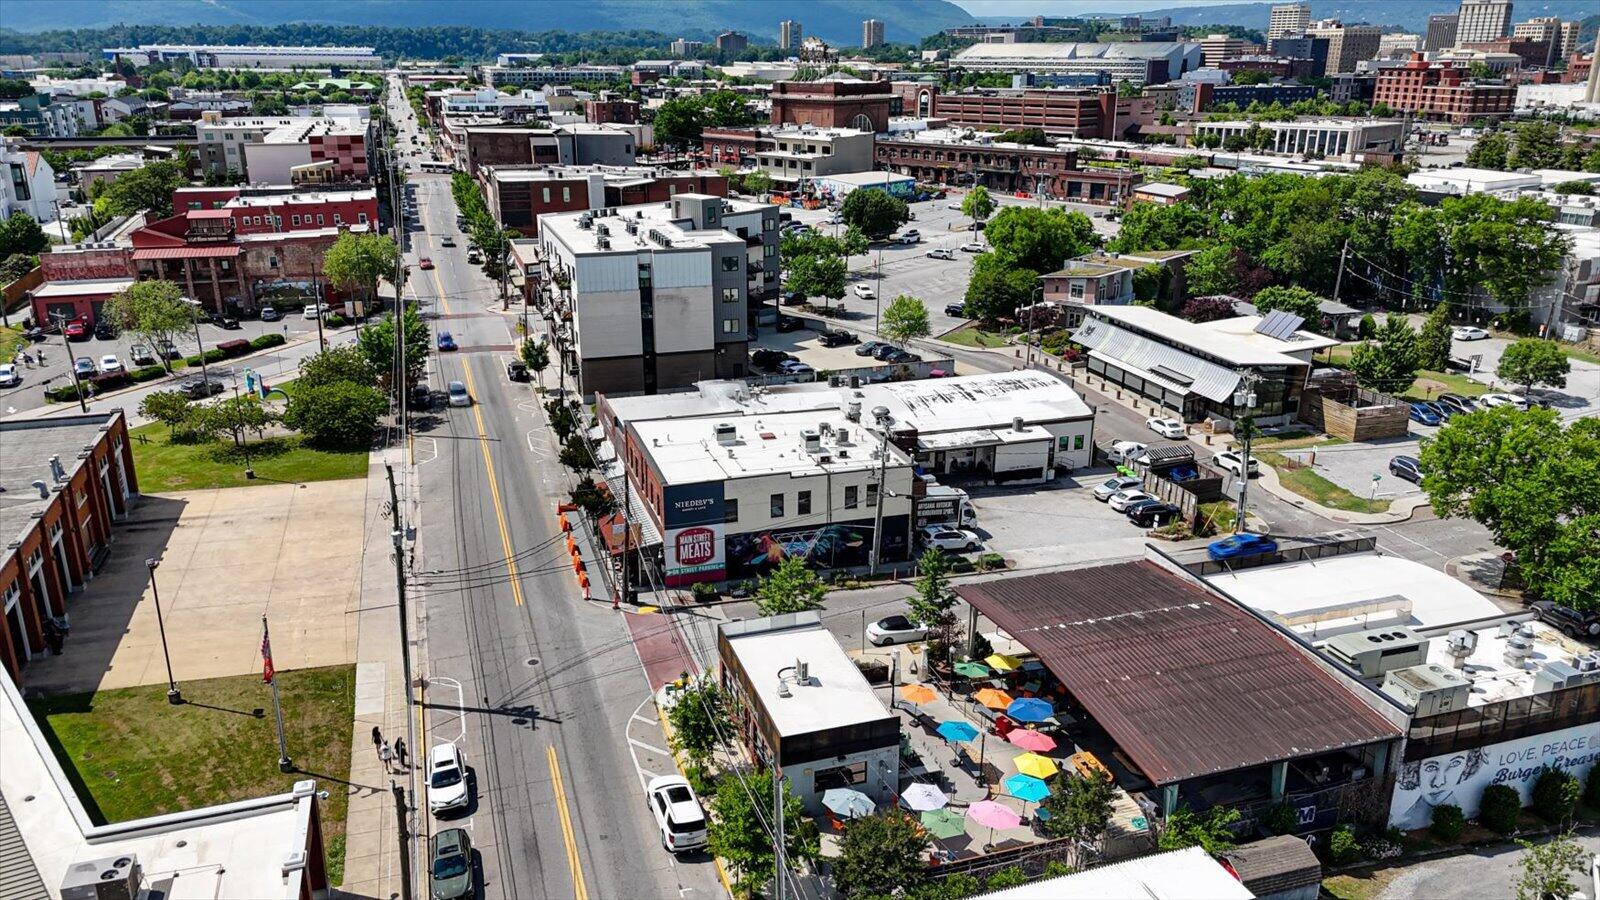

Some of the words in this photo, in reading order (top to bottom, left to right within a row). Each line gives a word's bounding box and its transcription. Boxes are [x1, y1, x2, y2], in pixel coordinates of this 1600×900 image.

[679, 535, 693, 545] MAIN
[693, 532, 711, 543] STREET
[680, 541, 711, 560] MEATS
[1542, 736, 1587, 756] PEACE
